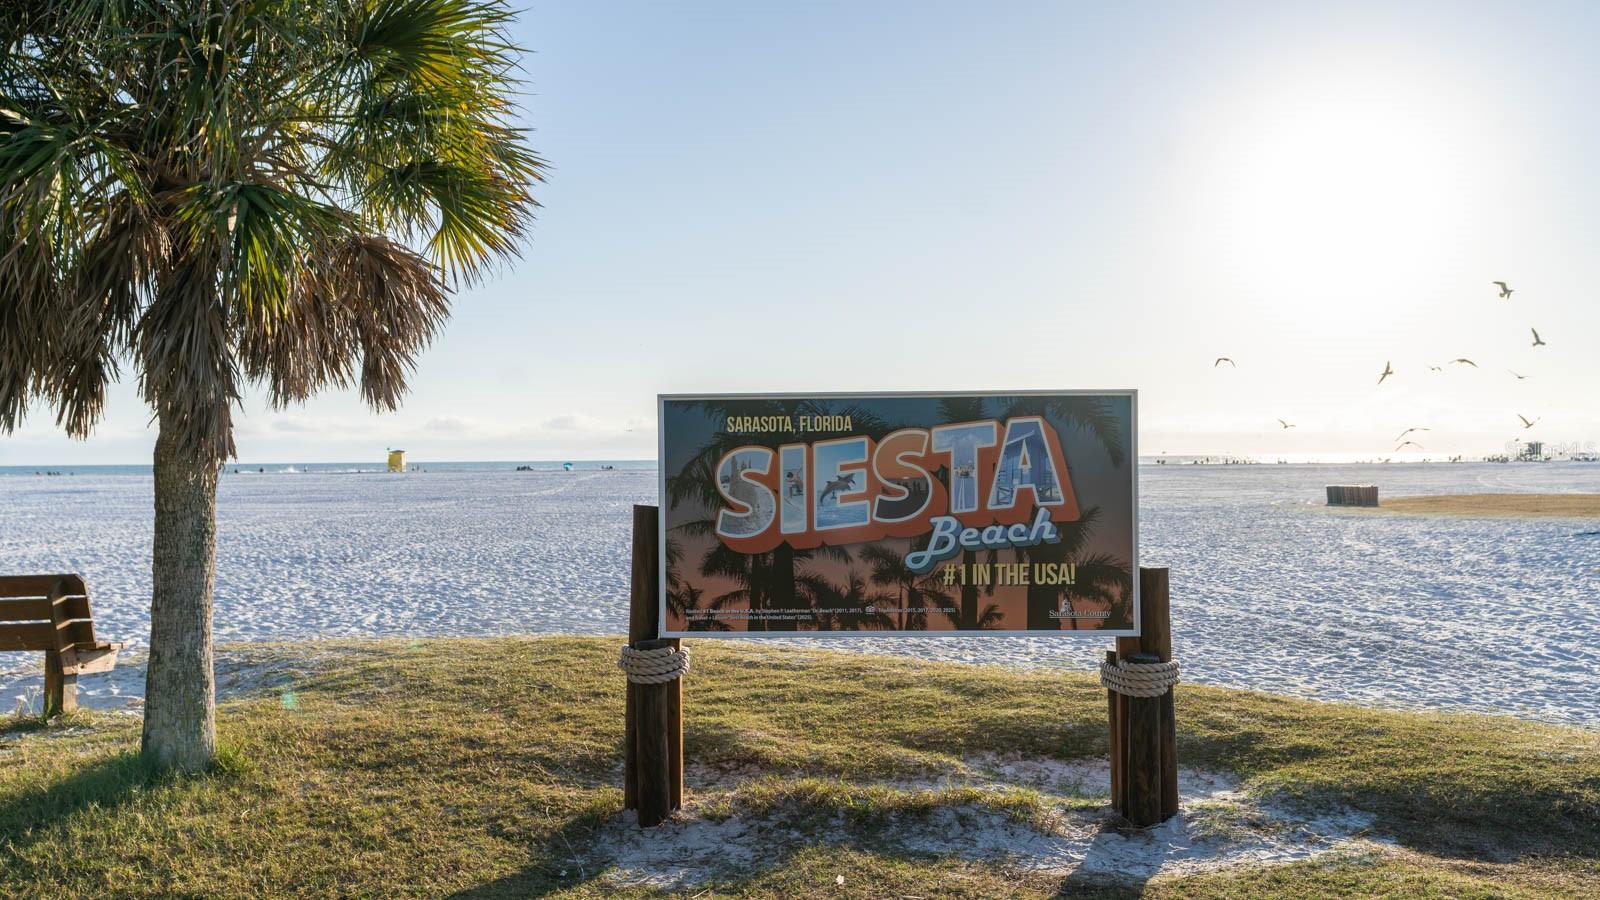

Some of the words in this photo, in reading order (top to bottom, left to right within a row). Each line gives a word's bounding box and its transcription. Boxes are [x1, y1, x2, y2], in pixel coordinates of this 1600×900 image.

[727, 416, 796, 434] SARASOTA,
[799, 416, 853, 432] FLORIDA
[716, 416, 1065, 538] SIESTA
[905, 508, 1057, 570] Beach
[943, 564, 967, 585] #1
[972, 564, 991, 585] IN
[995, 564, 1030, 585] THE
[1034, 563, 1076, 585] USA!
